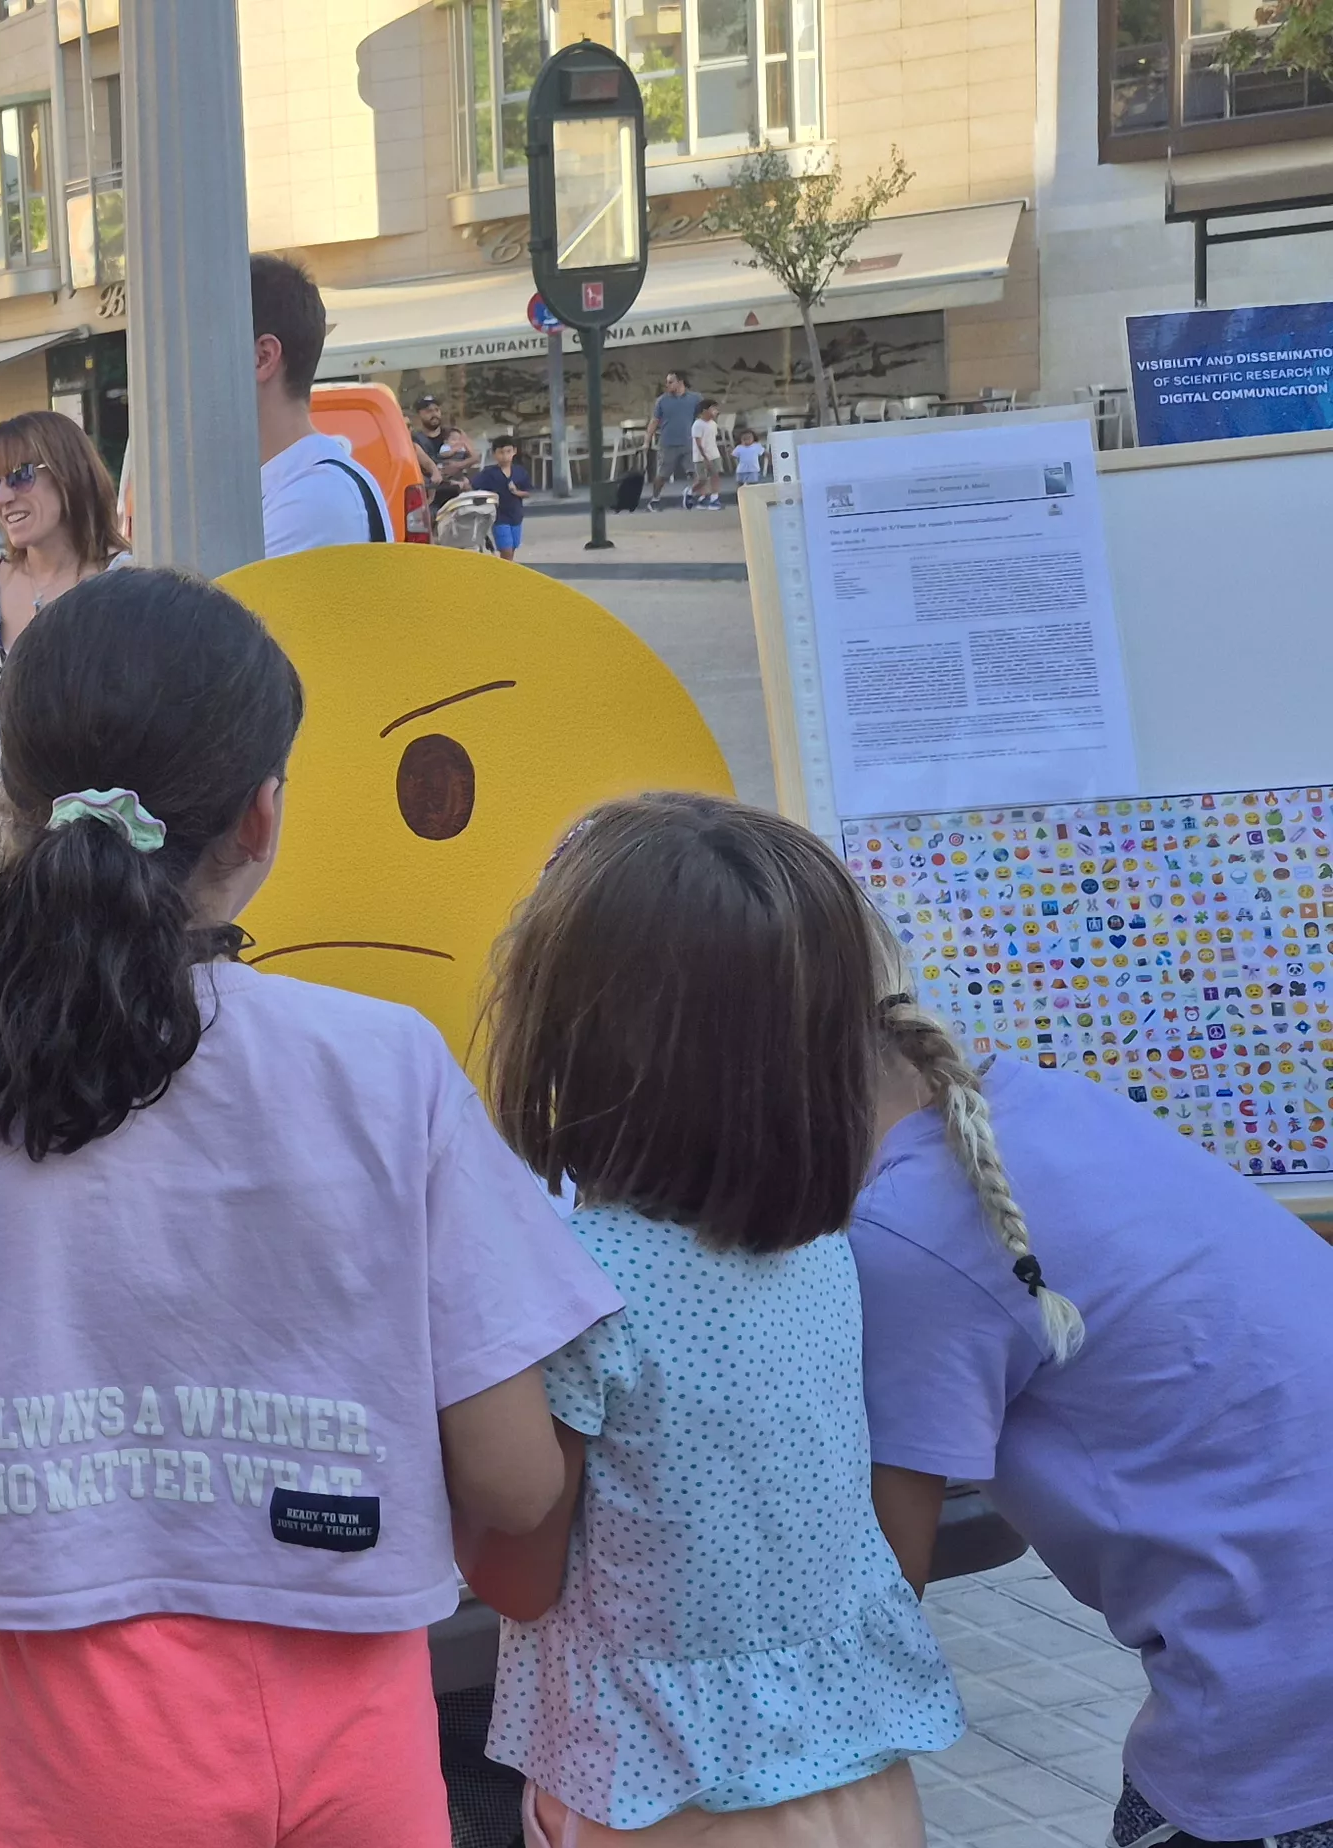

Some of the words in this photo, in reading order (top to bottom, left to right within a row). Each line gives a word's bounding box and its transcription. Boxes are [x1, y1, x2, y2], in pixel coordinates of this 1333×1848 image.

[439, 337, 549, 360] RESTAURANTE
[641, 320, 692, 336] ANITA
[1136, 356, 1203, 371] VISIBILITY
[1205, 355, 1234, 367] AND
[1153, 377, 1171, 388] OF
[1173, 371, 1243, 386] SCIENTIFIC
[1246, 366, 1313, 381] RESEARCH
[1316, 365, 1330, 377] IN
[1159, 392, 1210, 405] DIGITAL
[1212, 382, 1329, 401] COMMUNICATION
[133, 1385, 165, 1437] A
[174, 1385, 387, 1463] WINNER,
[43, 1448, 215, 1512] MATTER
[276, 1518, 299, 1530] JUST
[300, 1523, 323, 1533] PLAY
[345, 1526, 374, 1537] GAME
[286, 1507, 319, 1521] READY
[321, 1512, 336, 1523] TO
[337, 1513, 359, 1525] WIN
